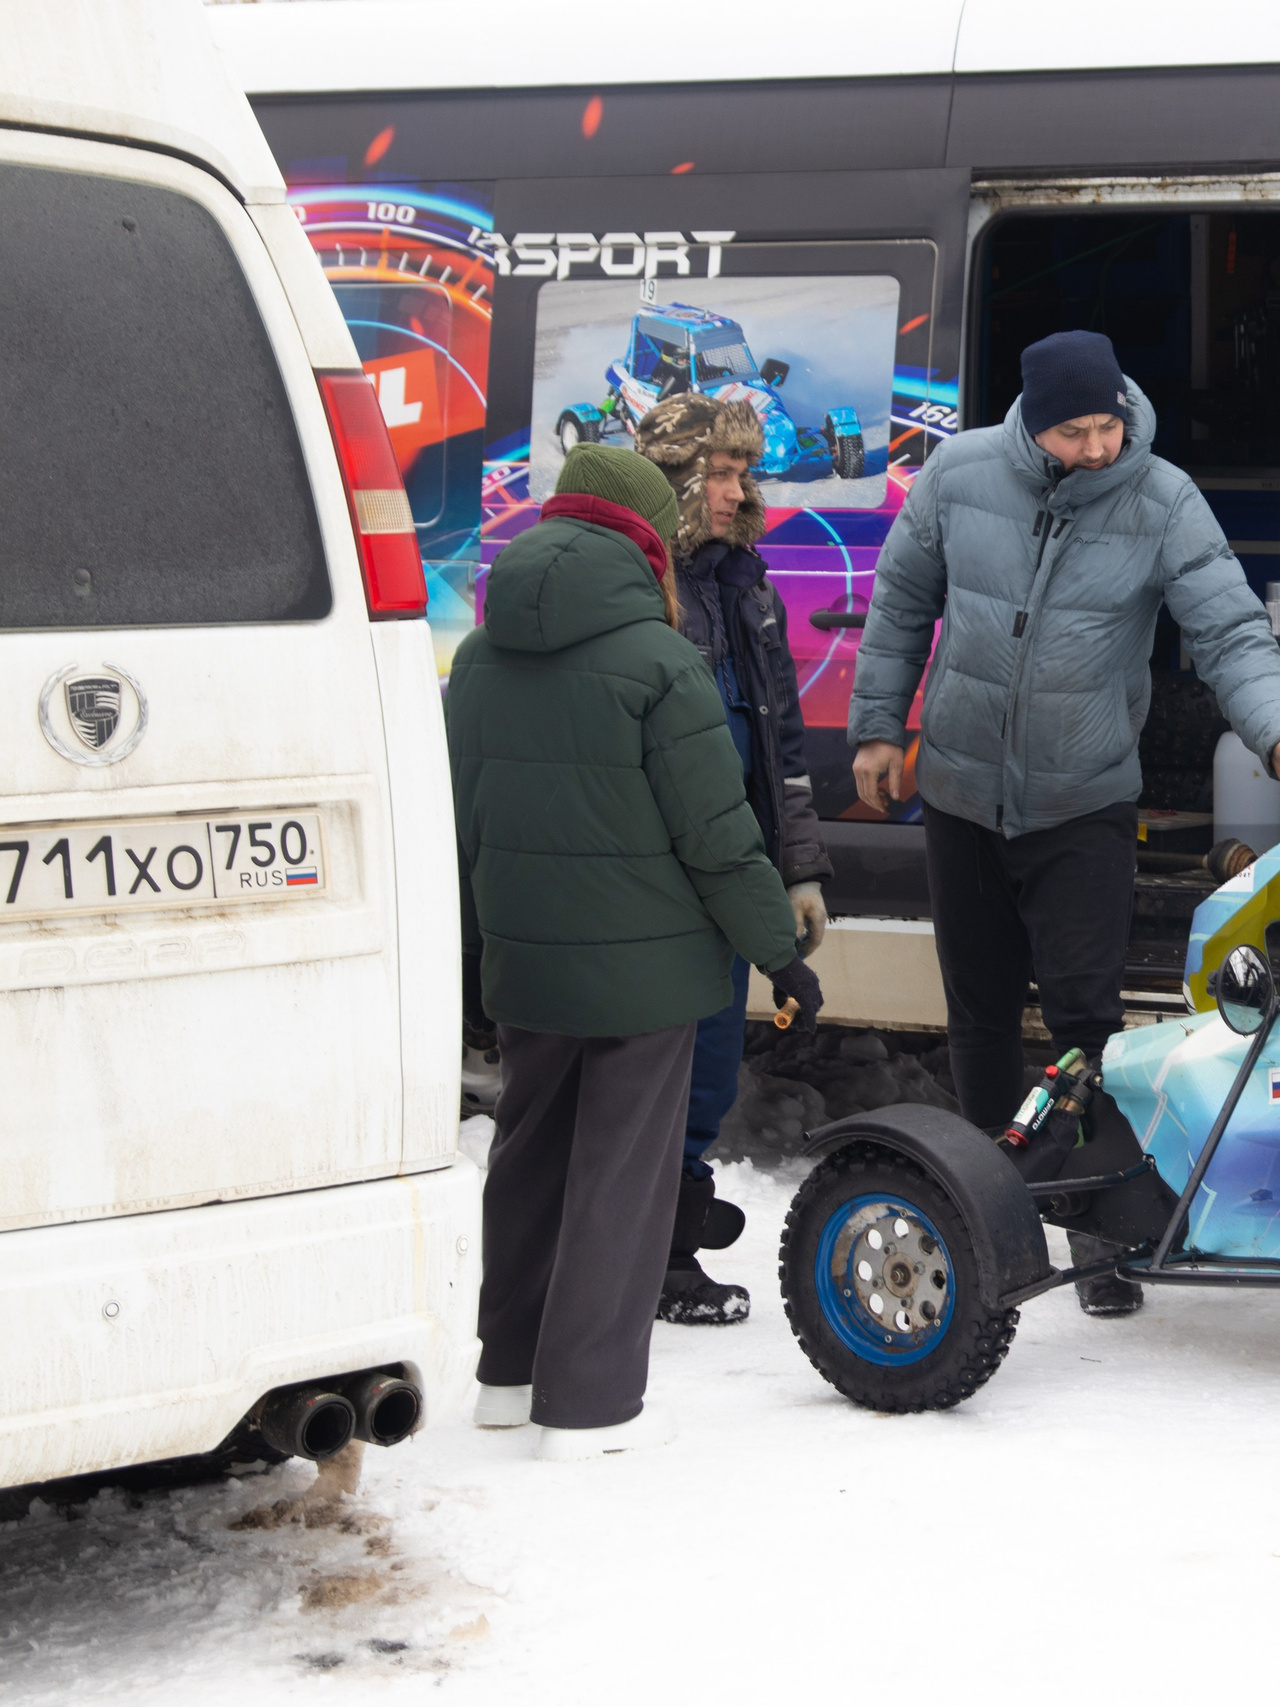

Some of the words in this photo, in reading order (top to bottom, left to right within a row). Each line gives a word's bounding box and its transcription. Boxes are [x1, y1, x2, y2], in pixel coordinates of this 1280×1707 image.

[367, 202, 416, 224] 100
[640, 279, 656, 300] 19
[215, 820, 308, 870] 750
[239, 869, 284, 889] RUS
